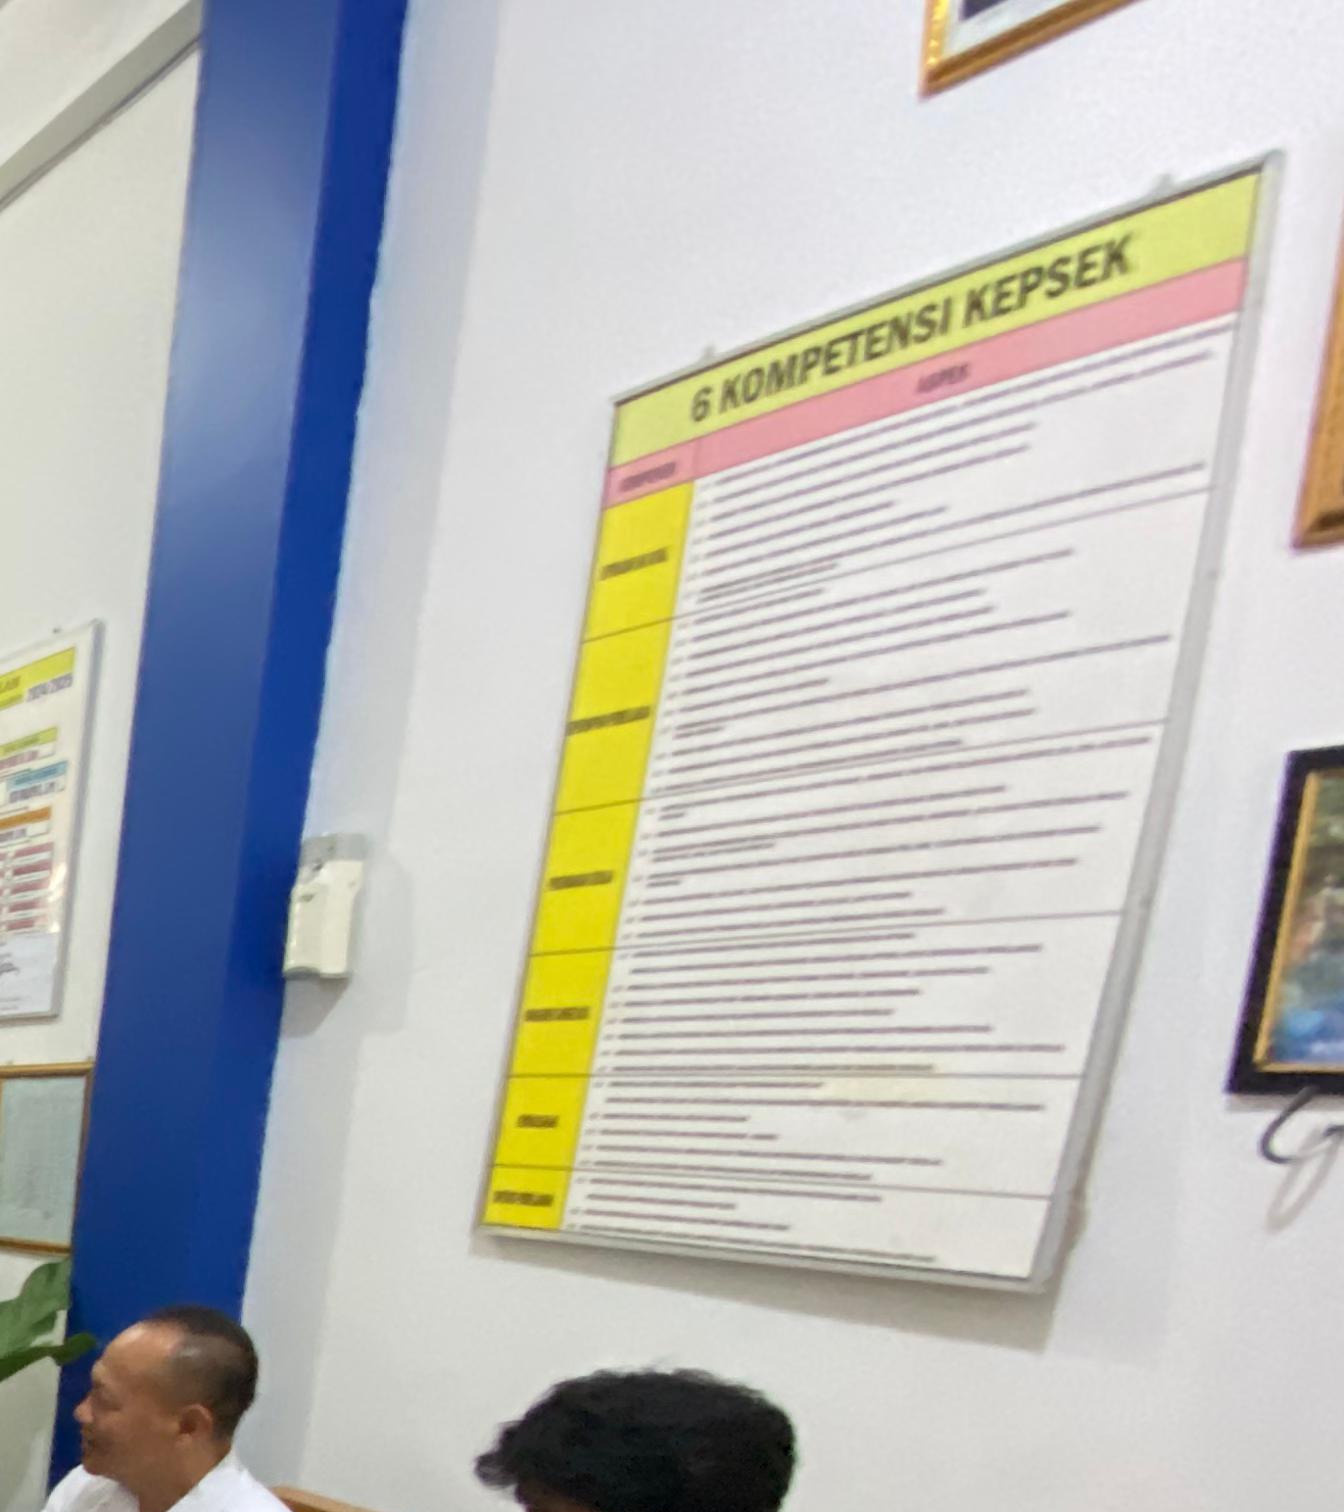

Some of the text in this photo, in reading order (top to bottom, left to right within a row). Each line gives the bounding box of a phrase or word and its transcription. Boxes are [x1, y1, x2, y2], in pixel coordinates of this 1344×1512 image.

[691, 232, 1134, 423] 6 KOMPETENSI KEPSEK
